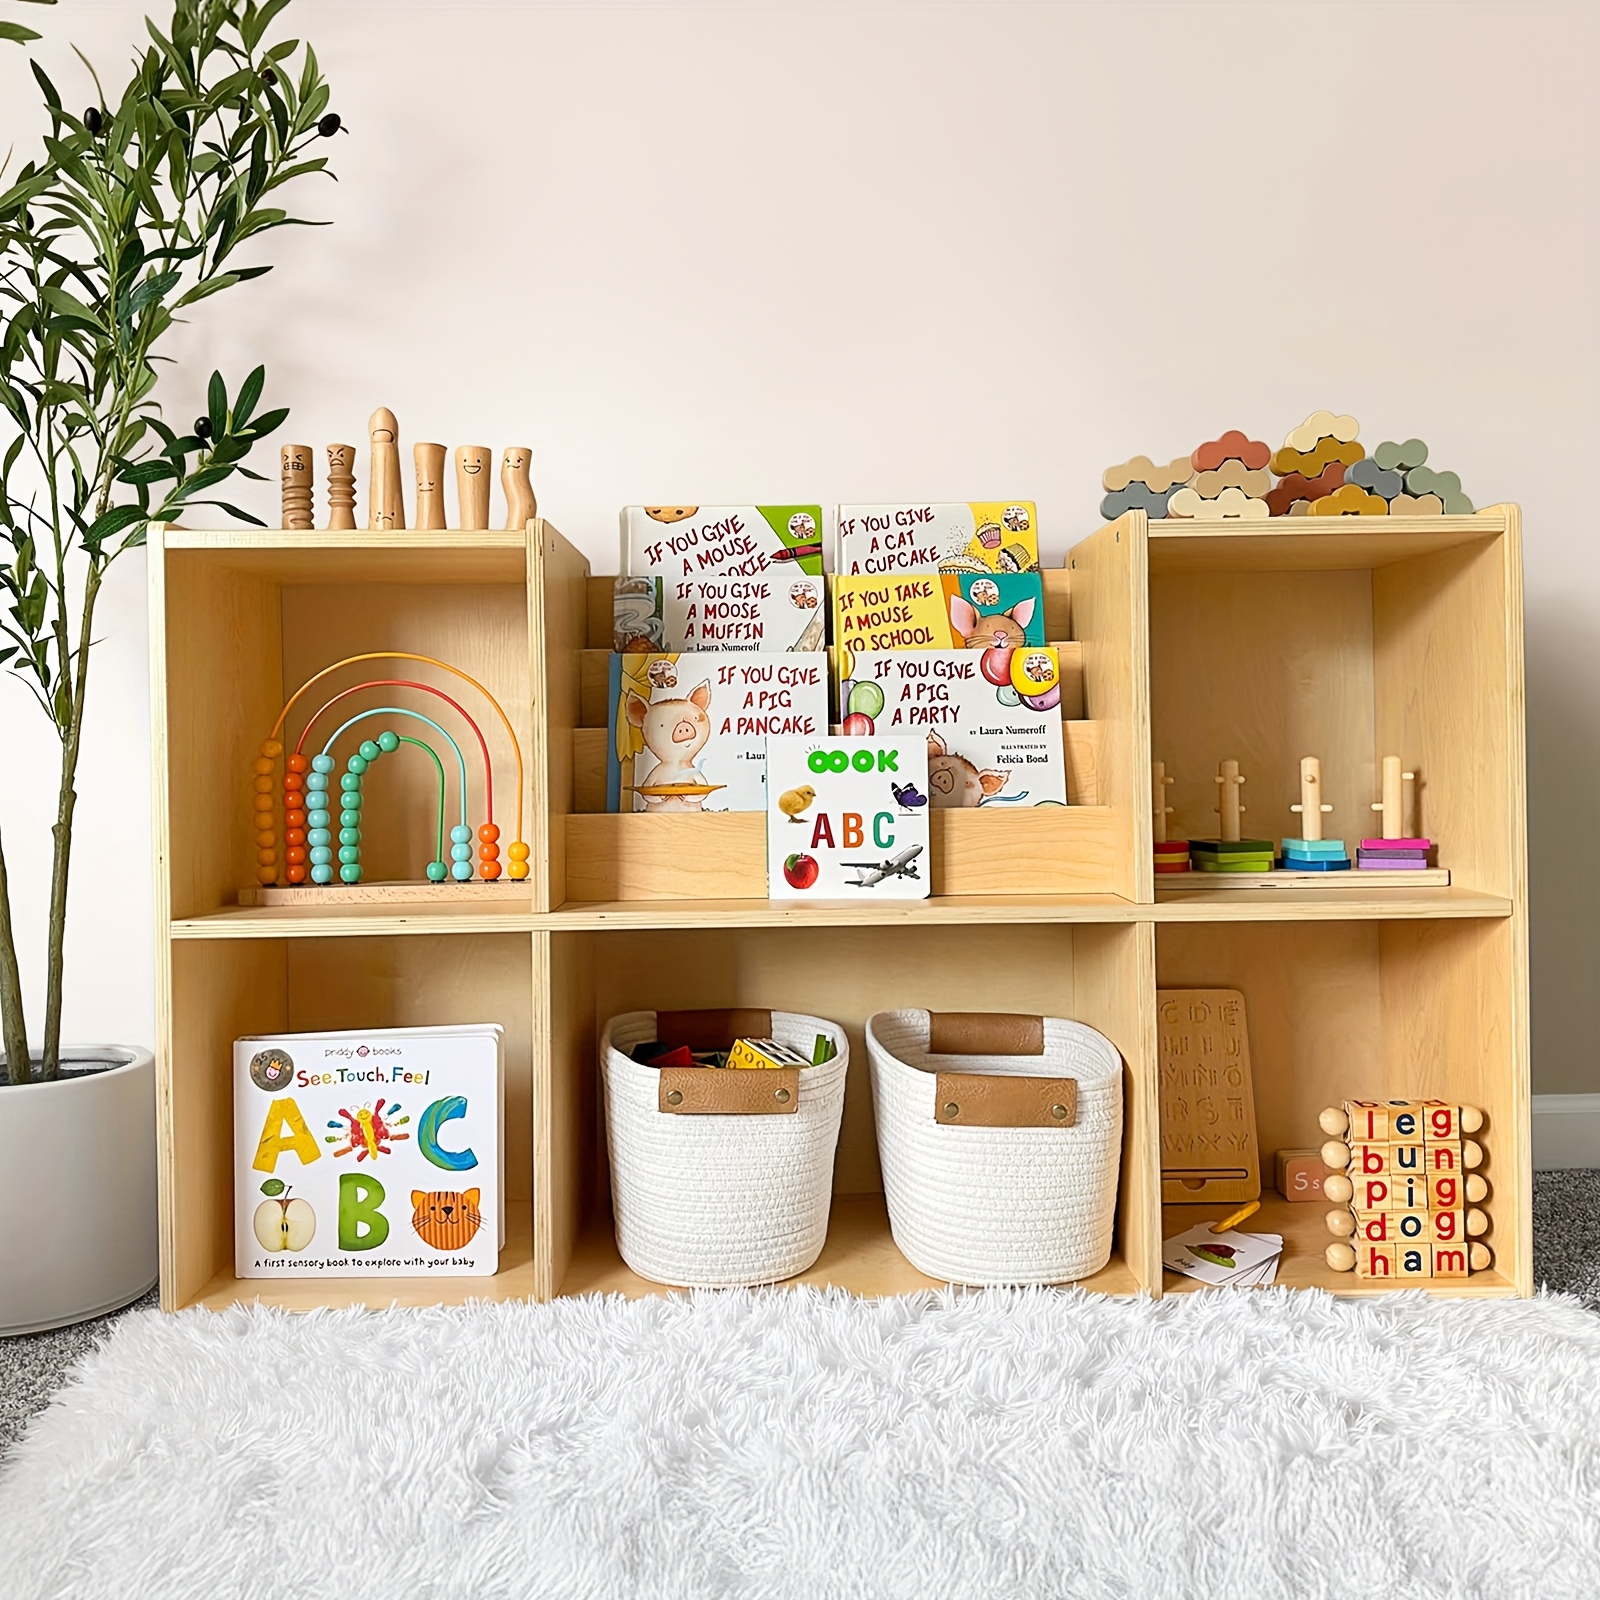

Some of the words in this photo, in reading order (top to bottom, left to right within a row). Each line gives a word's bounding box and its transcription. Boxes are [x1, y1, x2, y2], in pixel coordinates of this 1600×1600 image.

[840, 519, 855, 537] IF
[861, 514, 890, 533] YOU
[895, 507, 935, 526] GIVE
[644, 542, 662, 566] IF
[666, 528, 698, 555] YOU
[702, 514, 745, 542] GIVE
[870, 537, 879, 553] A
[884, 530, 914, 550] CAT
[683, 558, 693, 576] A
[697, 535, 757, 570] MOUSE
[851, 561, 860, 576] A
[865, 546, 940, 574] CUPCAKE
[676, 582, 694, 600] IF
[698, 584, 727, 599] YOU
[731, 582, 771, 600] GIVE
[839, 592, 854, 612] IF
[859, 588, 889, 607] YOU
[895, 581, 934, 599] TAKE
[686, 603, 697, 620] A
[704, 602, 761, 620] MOOSE
[844, 615, 853, 632] A
[857, 606, 913, 631] MOUSE
[684, 623, 694, 639] A
[702, 622, 764, 640] MUFFIN
[844, 636, 865, 652] TO
[871, 626, 934, 651] SCHOOL
[697, 642, 719, 651] Laura
[721, 642, 760, 651] Numeroff
[718, 665, 736, 685] IF
[741, 664, 773, 683] YOU
[777, 666, 820, 687] GIVE
[874, 659, 892, 680] IF
[897, 660, 930, 678] YOU
[934, 660, 976, 680] GIVE
[743, 692, 753, 709] A
[759, 690, 792, 711] PIG
[900, 684, 911, 701] A
[916, 683, 949, 703] PIG
[720, 718, 730, 735] A
[737, 715, 815, 735] PANCAKE
[892, 708, 902, 726] A
[910, 705, 960, 725] PARTY
[980, 727, 1004, 735] Laura
[1006, 726, 1046, 734] Numeroff
[997, 755, 1024, 763] Felicia
[1026, 754, 1048, 763] Bond
[325, 1048, 354, 1058] priddy
[373, 1047, 402, 1056] books
[252, 1097, 321, 1173] A
[418, 1096, 478, 1171] C
[1368, 1110, 1451, 1139] leg
[1363, 1146, 1453, 1174] bun
[1367, 1178, 1456, 1209] pig
[338, 1173, 389, 1251] B
[1366, 1212, 1455, 1241] dog
[264, 1259, 285, 1268] first
[288, 1260, 324, 1269] sensory
[352, 1258, 363, 1267] to
[365, 1259, 401, 1269] explore
[428, 1259, 449, 1268] your
[452, 1258, 474, 1268] baby
[1370, 1247, 1464, 1276] ham
